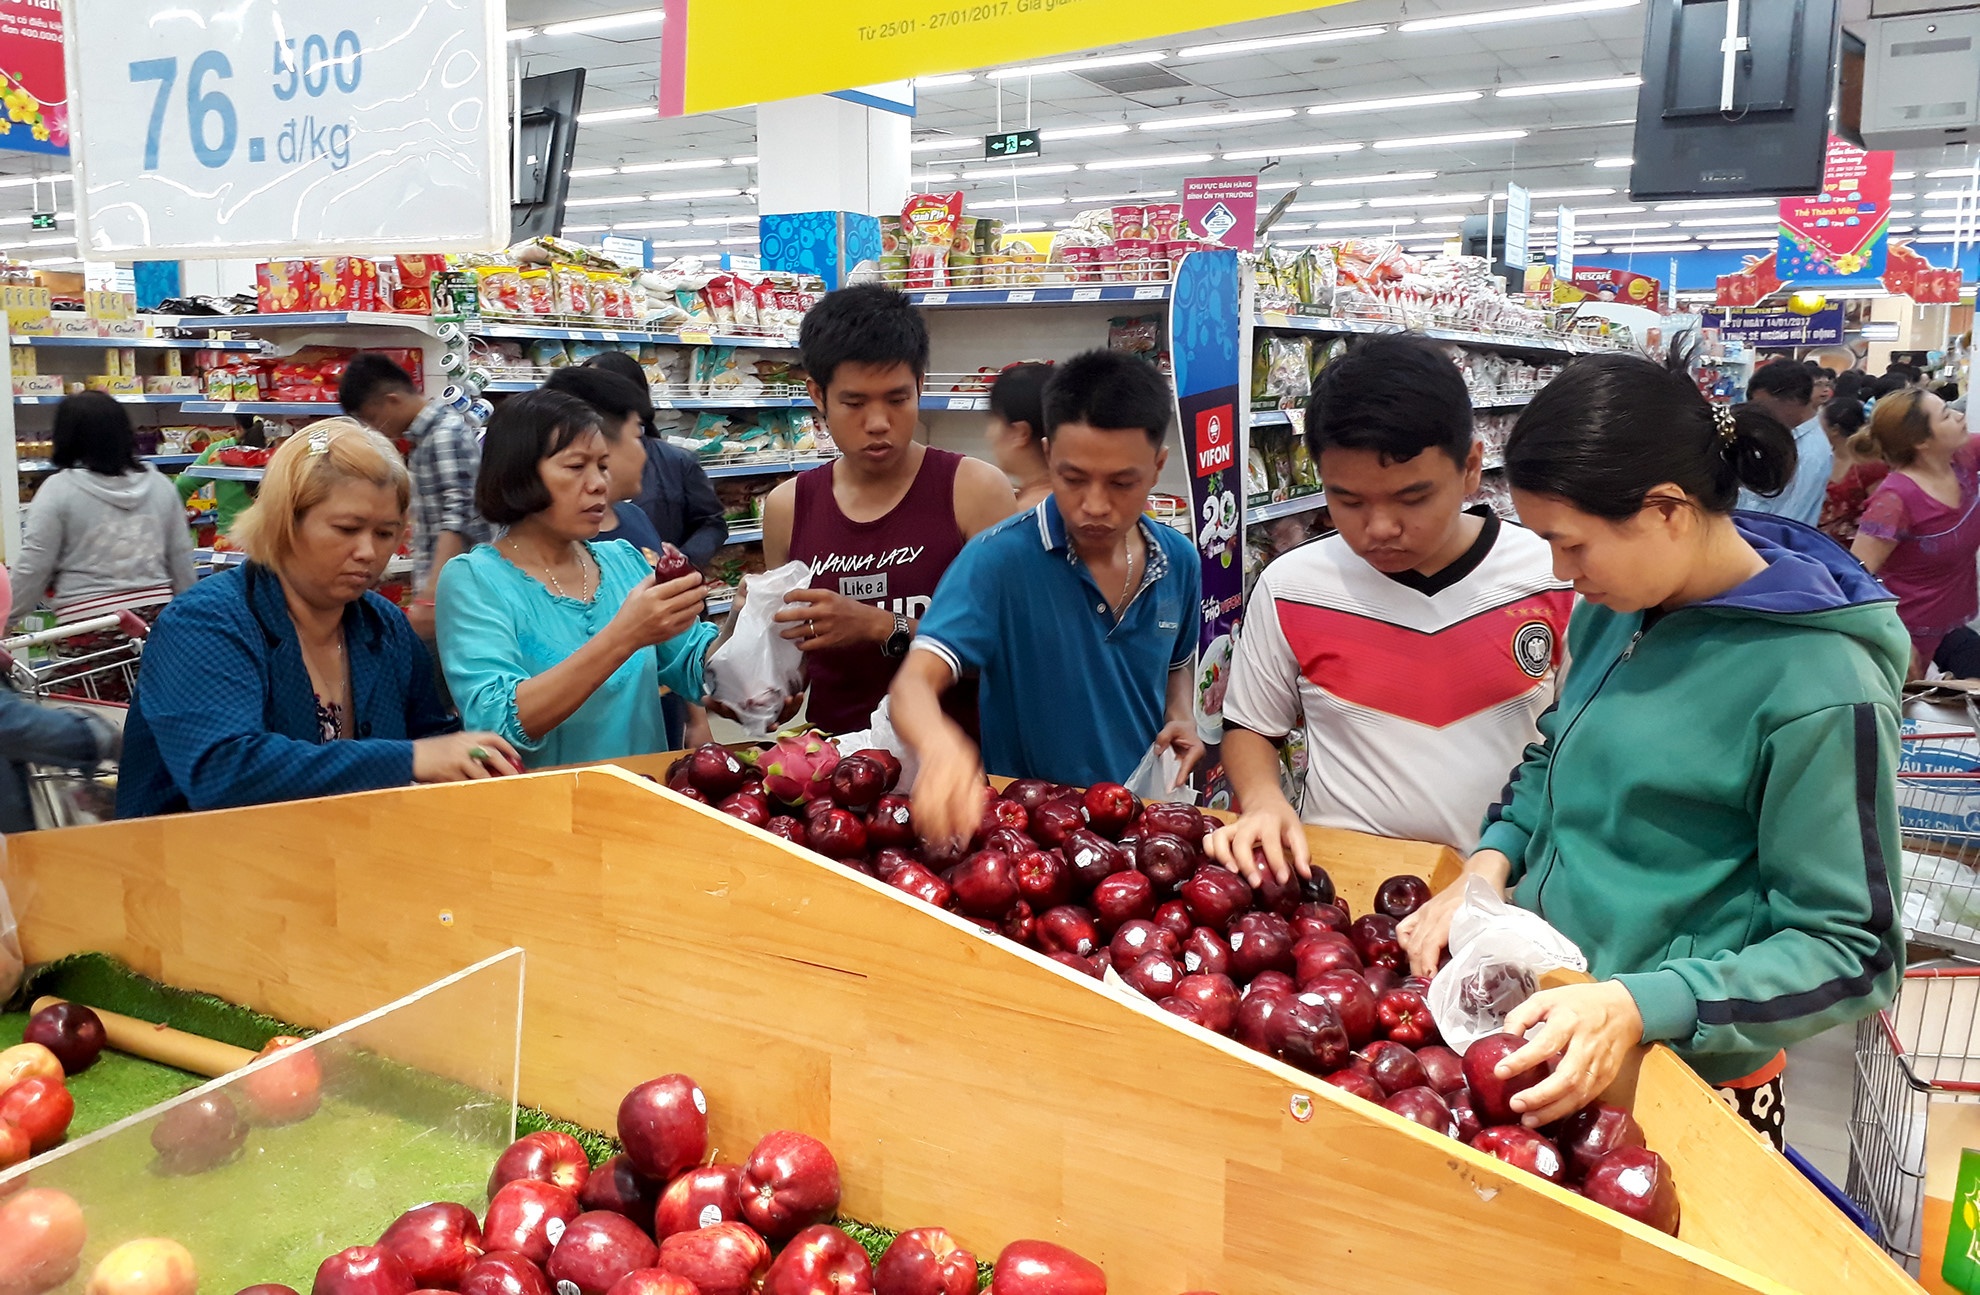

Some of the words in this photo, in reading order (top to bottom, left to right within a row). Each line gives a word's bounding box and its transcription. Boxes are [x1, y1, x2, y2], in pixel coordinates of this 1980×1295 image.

[879, 19, 916, 39] 25/01
[272, 29, 362, 101] 500
[277, 115, 350, 171] đ/kg
[1203, 182, 1218, 190] VỰC
[1218, 181, 1232, 189] BÁN
[1187, 192, 1203, 200] BÌNH
[1225, 191, 1254, 199] TRƯỜNG
[1575, 270, 1612, 280] NESCAFÉ
[1766, 317, 1811, 328] 14/01/2017
[1199, 444, 1231, 469] VIFON
[809, 552, 876, 576] WANNA
[876, 545, 924, 569] LAZY
[843, 581, 873, 596] Like
[876, 581, 884, 593] a
